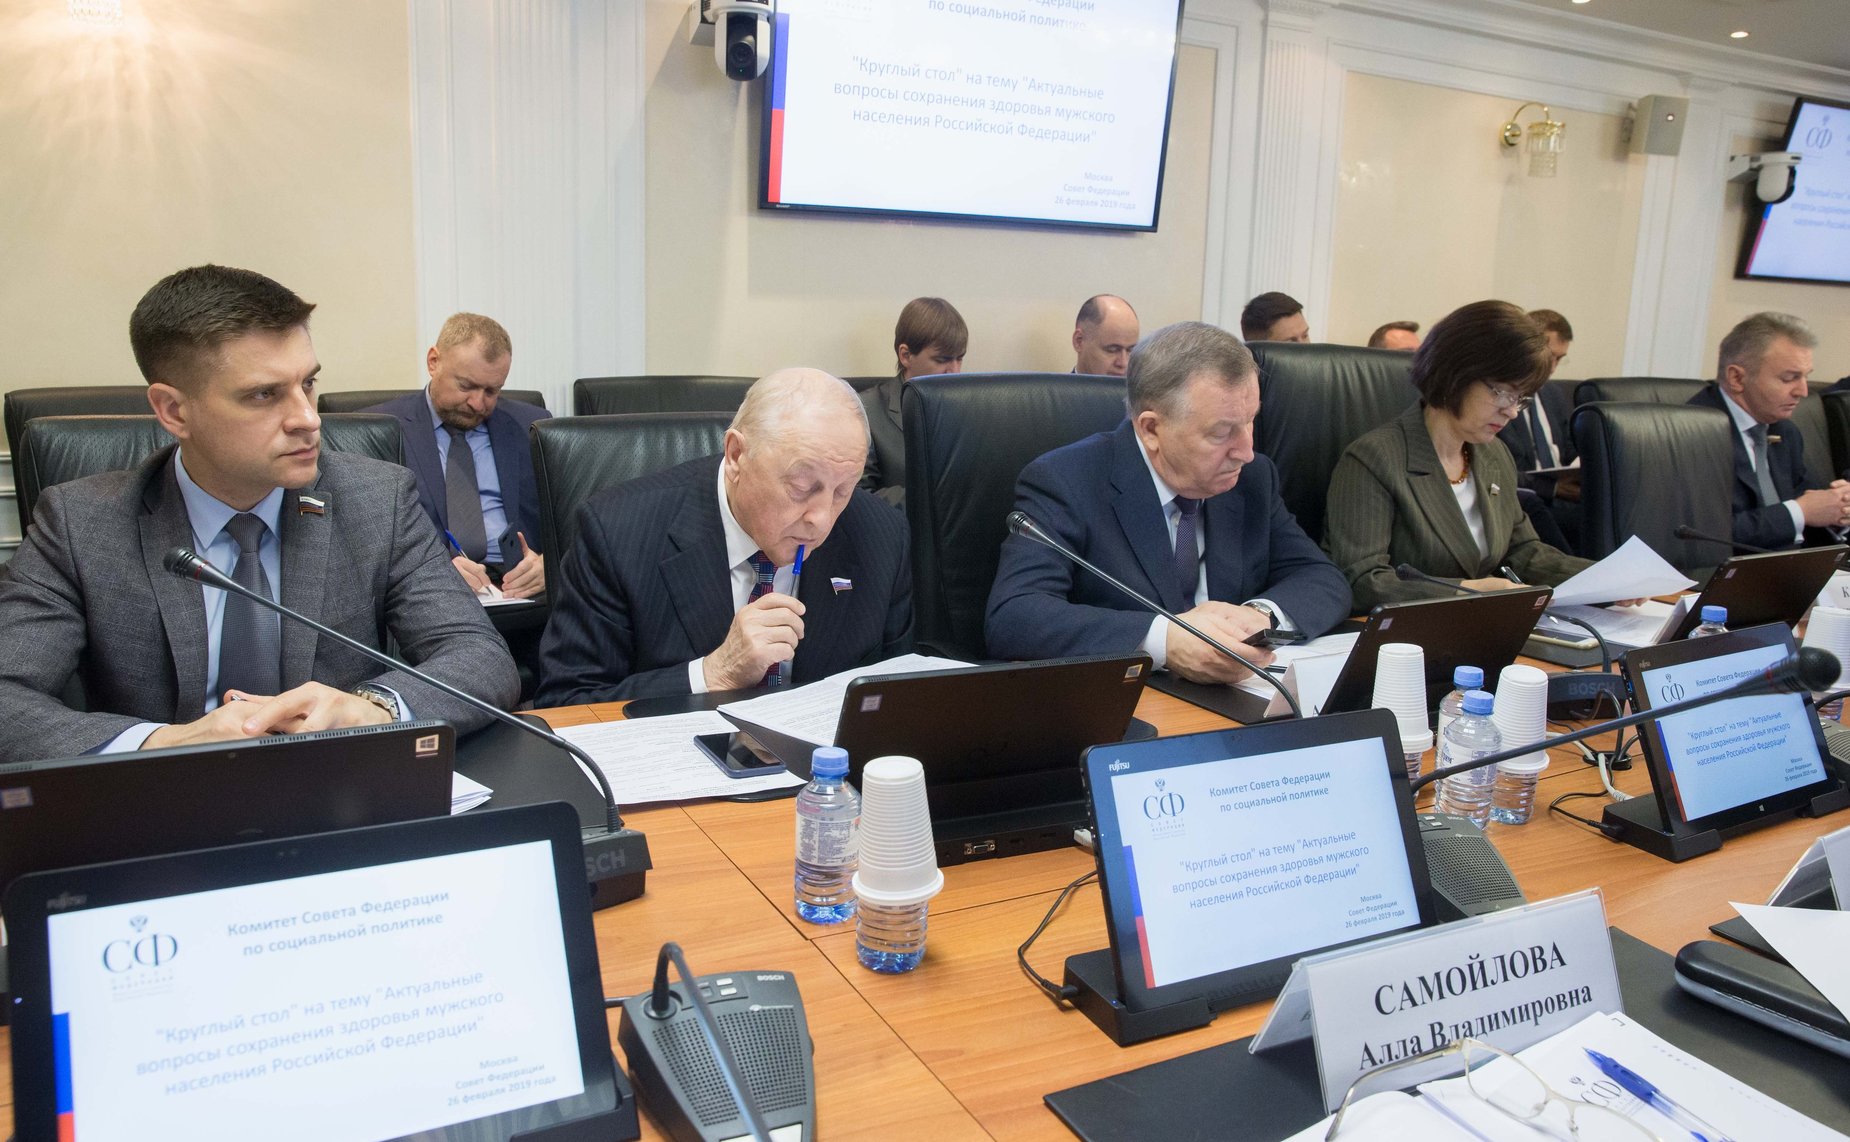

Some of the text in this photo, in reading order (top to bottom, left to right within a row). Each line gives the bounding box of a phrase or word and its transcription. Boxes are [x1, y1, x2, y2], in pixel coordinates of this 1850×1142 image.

[928, 0, 945, 11] по
[949, 2, 1026, 23] социальной
[1028, 0, 1095, 12] едерации
[852, 55, 1105, 100] "Круглый стол" на тему "Актуальные
[834, 82, 1116, 124] вопросы сохранения здоровья мужского
[853, 109, 1097, 143] населения Российской Федерации"
[1661, 682, 1685, 703] СФ
[1108, 759, 1130, 772] FUJITSU
[1209, 770, 1331, 798] Комитет Совета Федерации
[1143, 792, 1185, 821] СФ
[1220, 786, 1330, 813] по социальной политике
[1172, 845, 1370, 893] вопросы сохранения здоровья мужского
[1180, 830, 1357, 873] "Круглый стол" на тему "Актуальные
[1189, 863, 1360, 910] населения Российской Федерации"
[1360, 893, 1383, 903] Москва
[227, 891, 450, 936] Комитет Совета Федерации
[1348, 901, 1398, 917] Совет Федерации
[1392, 909, 1405, 918] года
[102, 933, 179, 974] СФ
[243, 912, 444, 957] по социальной политике
[757, 974, 785, 982] BOSCH
[1374, 941, 1568, 1016] САМОЙЛОВА
[155, 971, 484, 1044] "Круглый стол" на тему "Актуальные
[1359, 985, 1593, 1071] Алла Владимировна
[135, 990, 505, 1076] вопросы сохранения здоровья мужского
[165, 1015, 485, 1096] населения Российской Федерации"
